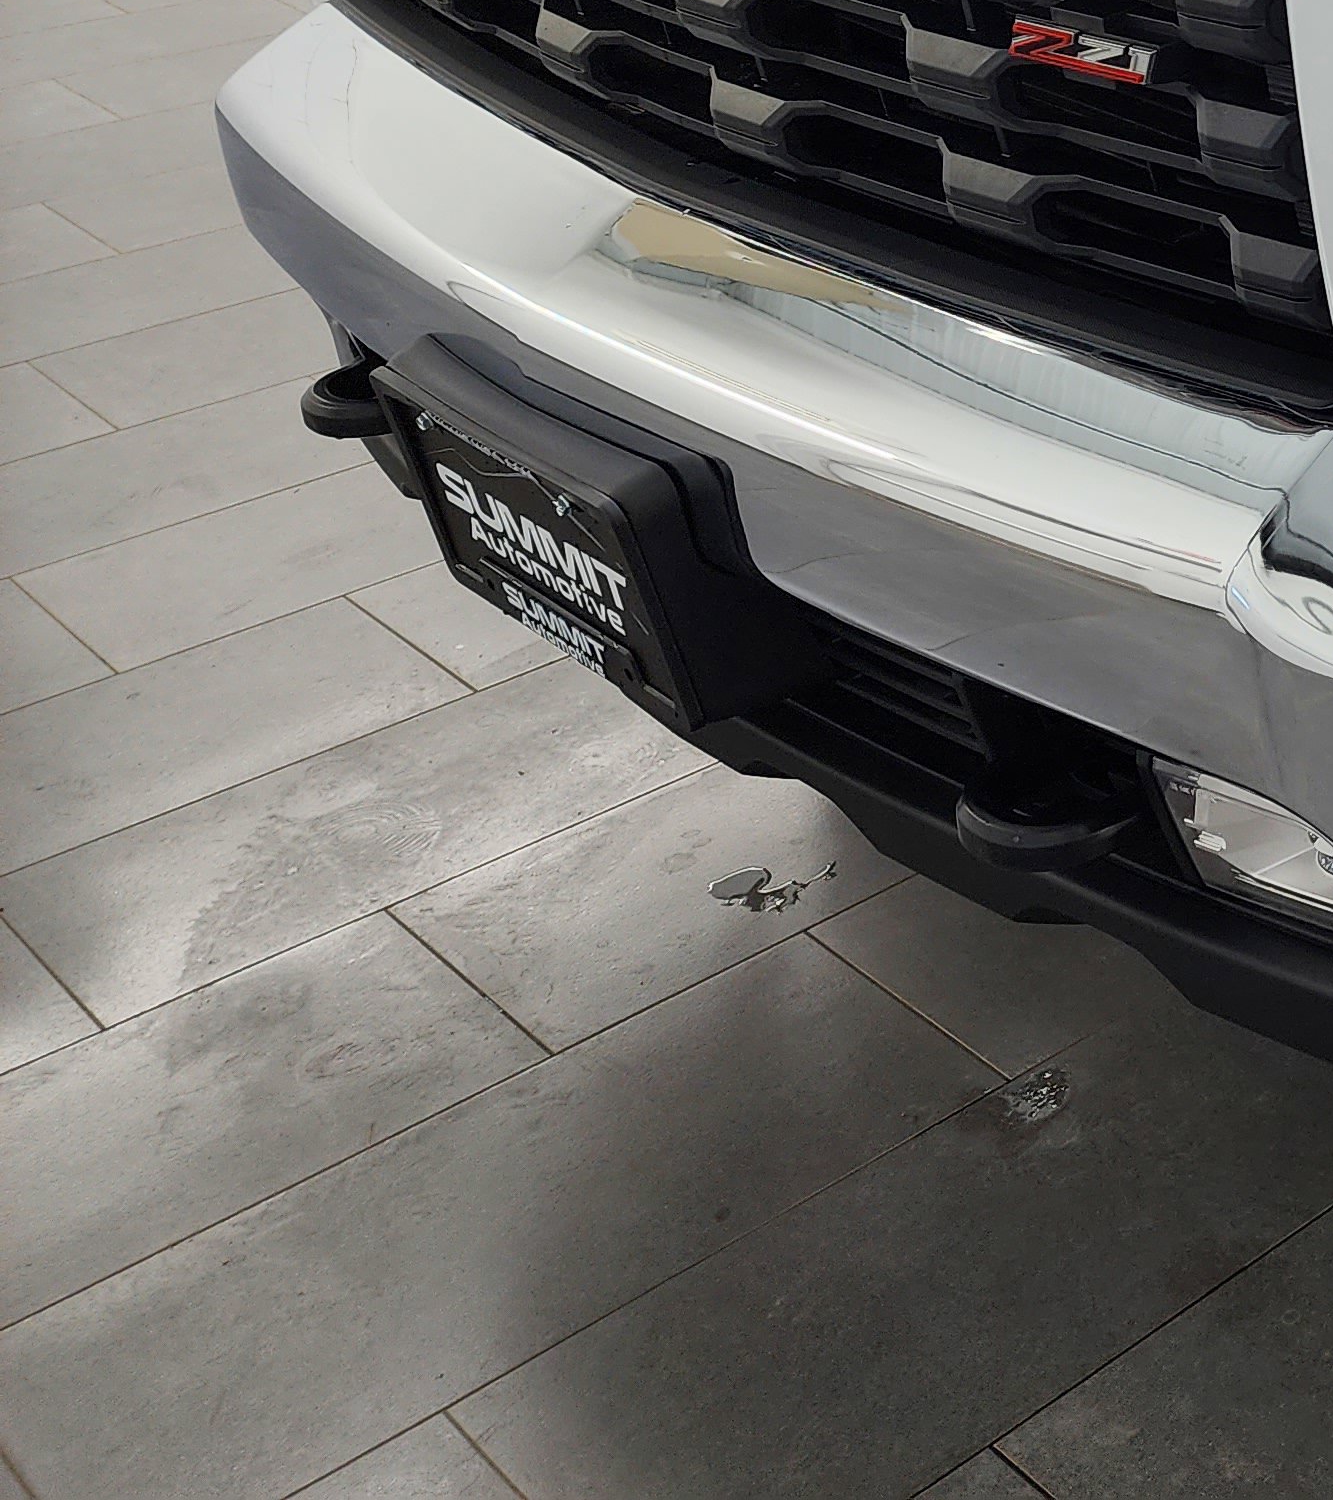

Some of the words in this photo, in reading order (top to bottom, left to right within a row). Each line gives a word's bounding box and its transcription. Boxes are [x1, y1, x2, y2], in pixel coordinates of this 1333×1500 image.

[1008, 14, 1160, 85] Z71
[436, 463, 627, 611] SUMMIT
[470, 516, 627, 637] Automotive
[501, 581, 605, 665] SUMMIT
[521, 612, 606, 679] Automotive
